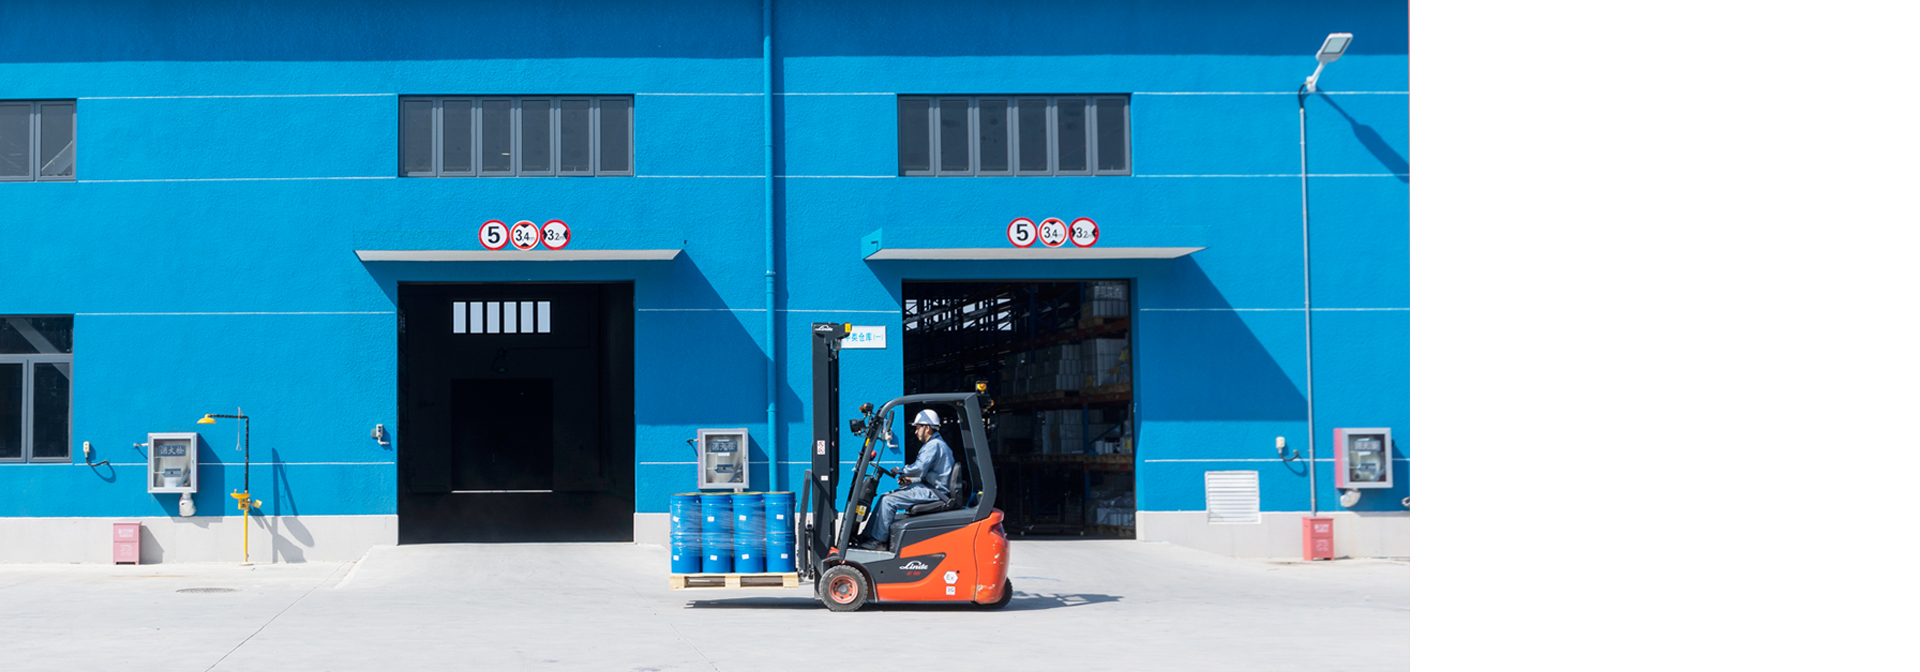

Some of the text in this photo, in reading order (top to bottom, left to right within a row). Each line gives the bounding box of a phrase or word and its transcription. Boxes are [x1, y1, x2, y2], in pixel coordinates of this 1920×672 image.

[487, 226, 500, 244] 5
[1017, 223, 1029, 242] 5
[899, 560, 929, 570] Linde
